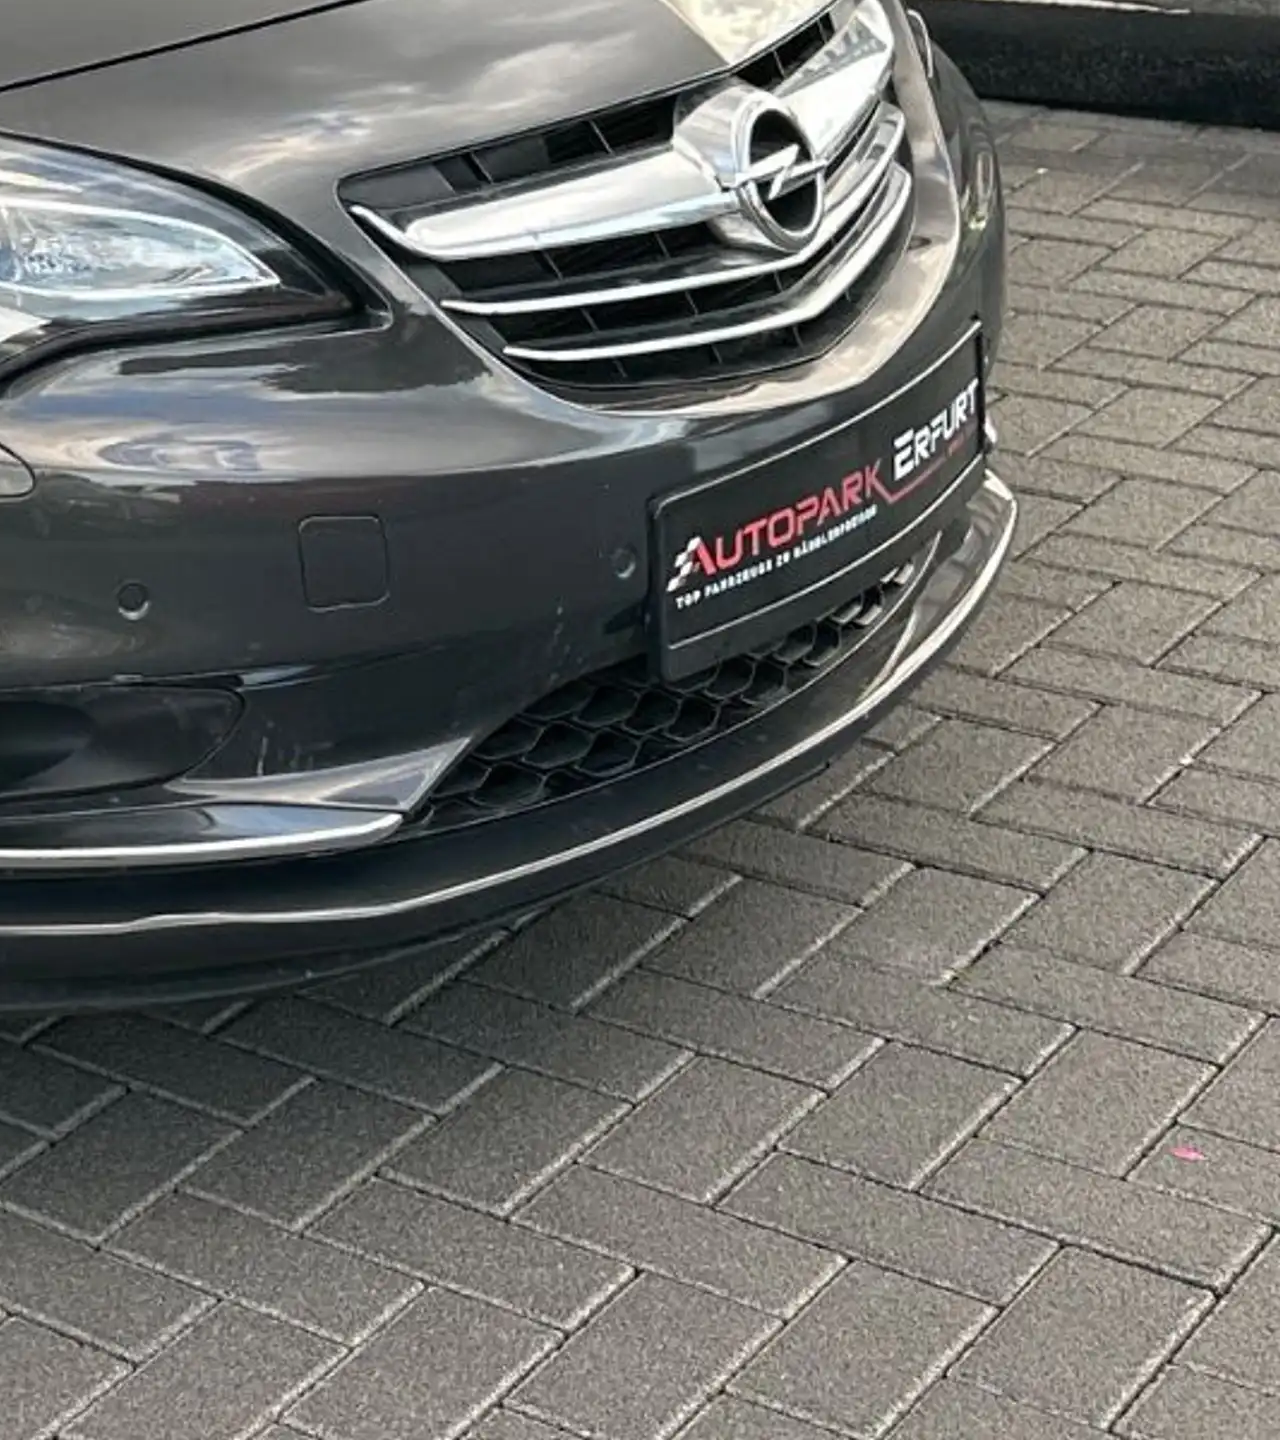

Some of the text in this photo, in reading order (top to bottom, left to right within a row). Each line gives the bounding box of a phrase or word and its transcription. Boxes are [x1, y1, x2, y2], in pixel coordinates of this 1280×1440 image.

[666, 378, 979, 593] AUTOPARK ERFURT
[675, 590, 702, 610] TOP
